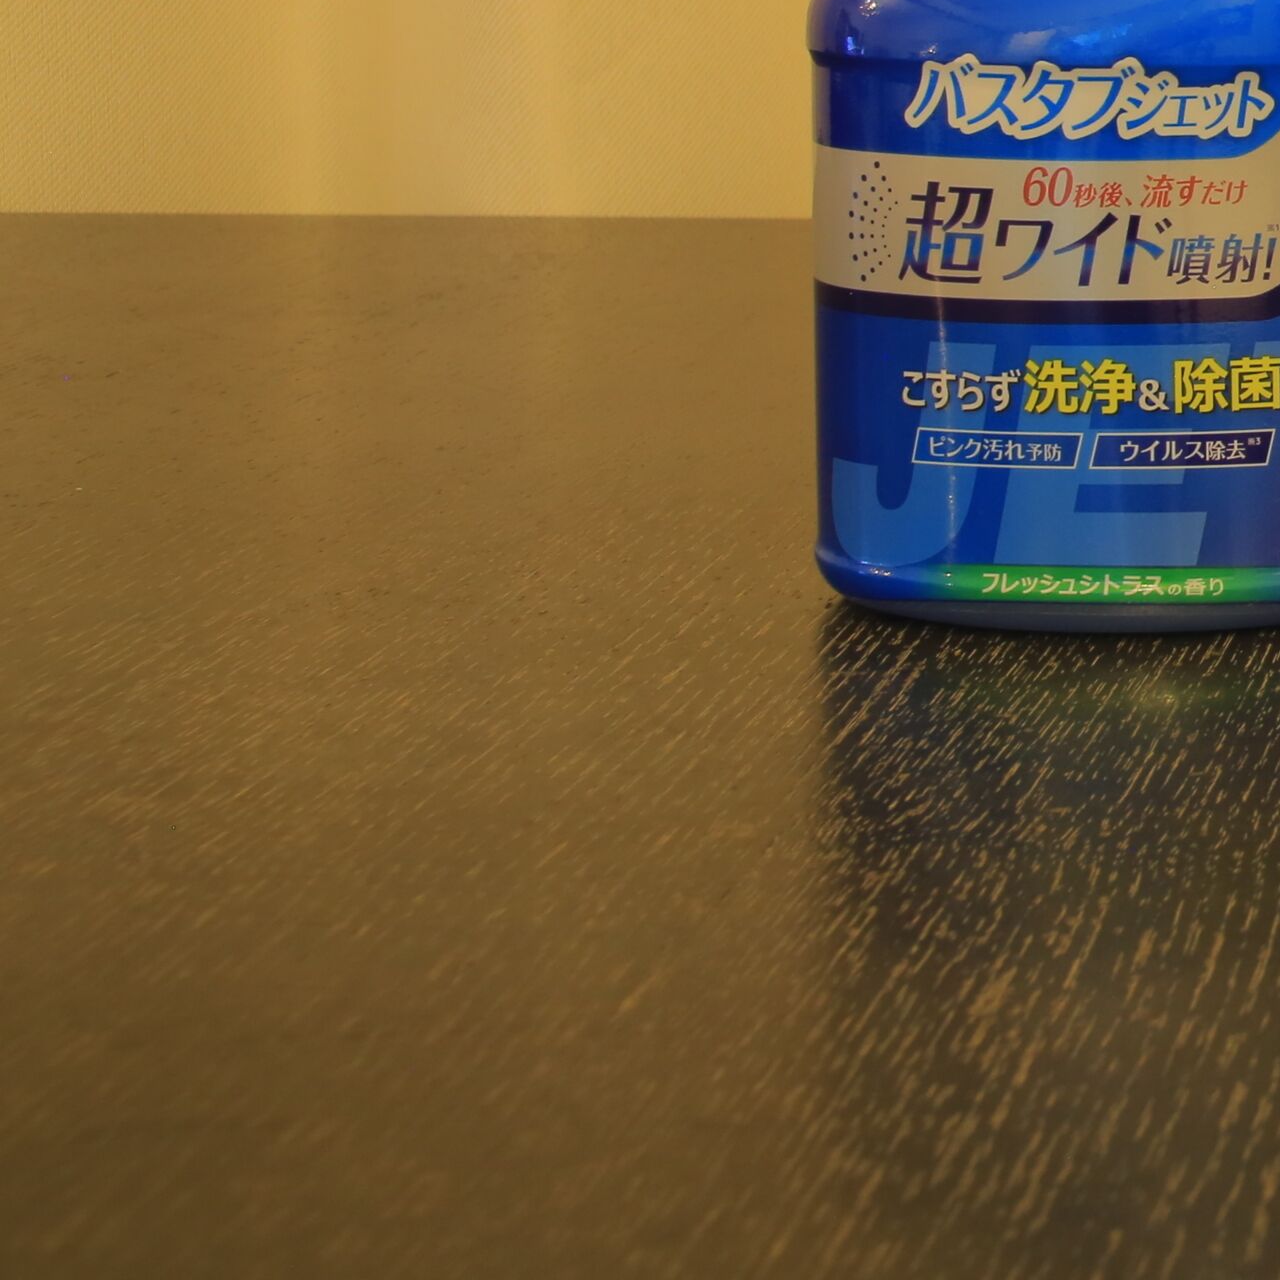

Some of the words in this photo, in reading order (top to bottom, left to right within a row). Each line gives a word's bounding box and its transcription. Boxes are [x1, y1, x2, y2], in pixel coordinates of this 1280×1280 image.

[910, 58, 1269, 133] バスタブジェット
[1022, 166, 1249, 209] 60秒後、流すだけ
[898, 180, 1278, 288] 超ワイド噴射!
[928, 434, 1063, 463] ピンク汚れ予防
[1119, 437, 1246, 463] ウイルス除去
[980, 571, 1225, 598] フレッシュシトラスの香り
